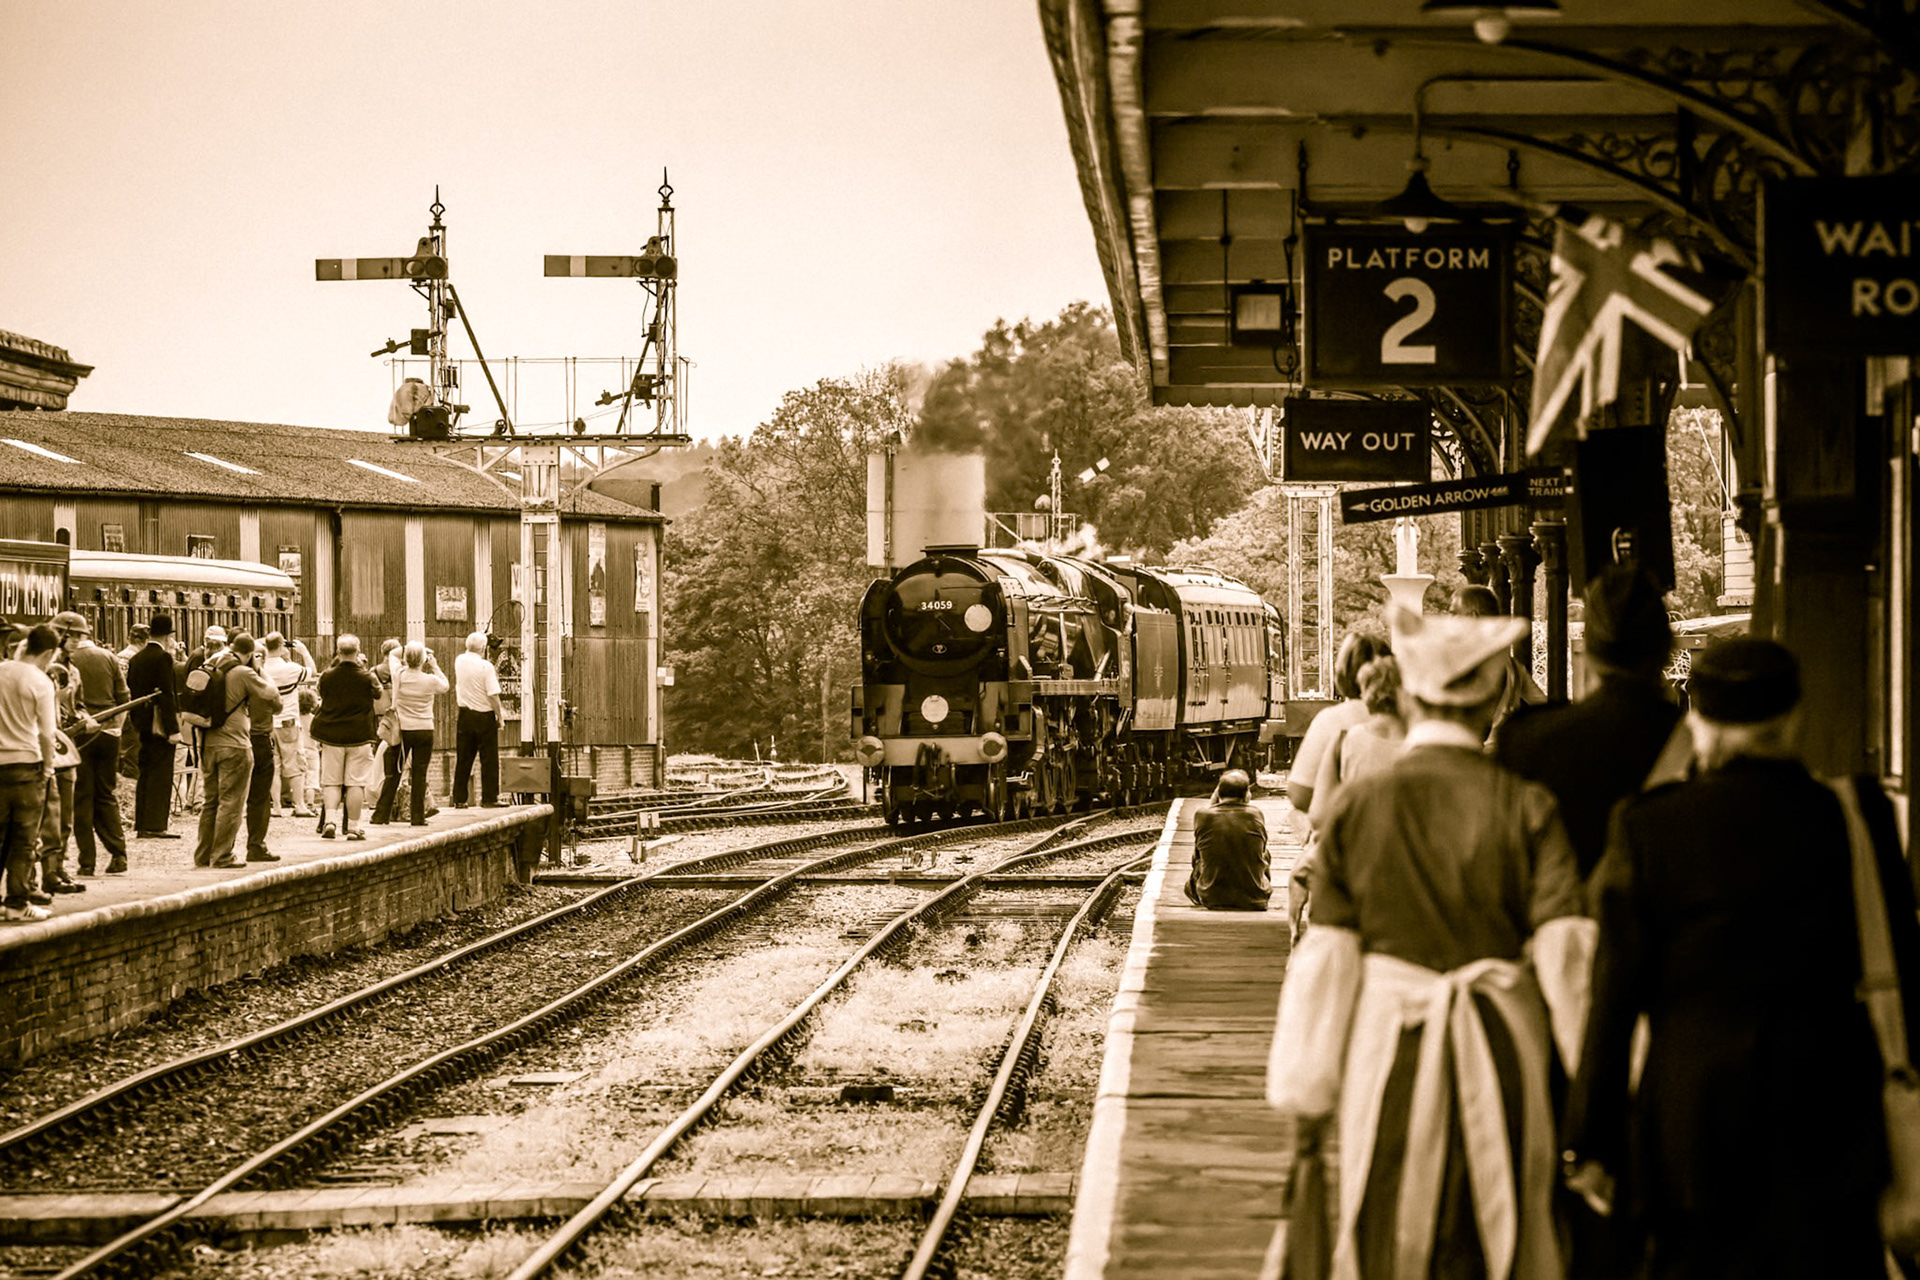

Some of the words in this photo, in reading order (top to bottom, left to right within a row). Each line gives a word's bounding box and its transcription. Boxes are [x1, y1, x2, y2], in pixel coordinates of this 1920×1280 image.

[1327, 248, 1490, 270] PLATFORM
[1852, 278, 1920, 316] RO
[1381, 277, 1437, 364] 2
[1300, 431, 1352, 451] WAY
[1362, 432, 1415, 451] OUT
[1527, 486, 1564, 497] TRAIN
[1529, 477, 1559, 487] NEXT
[1370, 493, 1431, 513] GOLDEN
[1433, 487, 1490, 506] ARROW
[0, 573, 19, 615] TED
[24, 574, 60, 617] KEYNES
[921, 600, 953, 611] 34059
